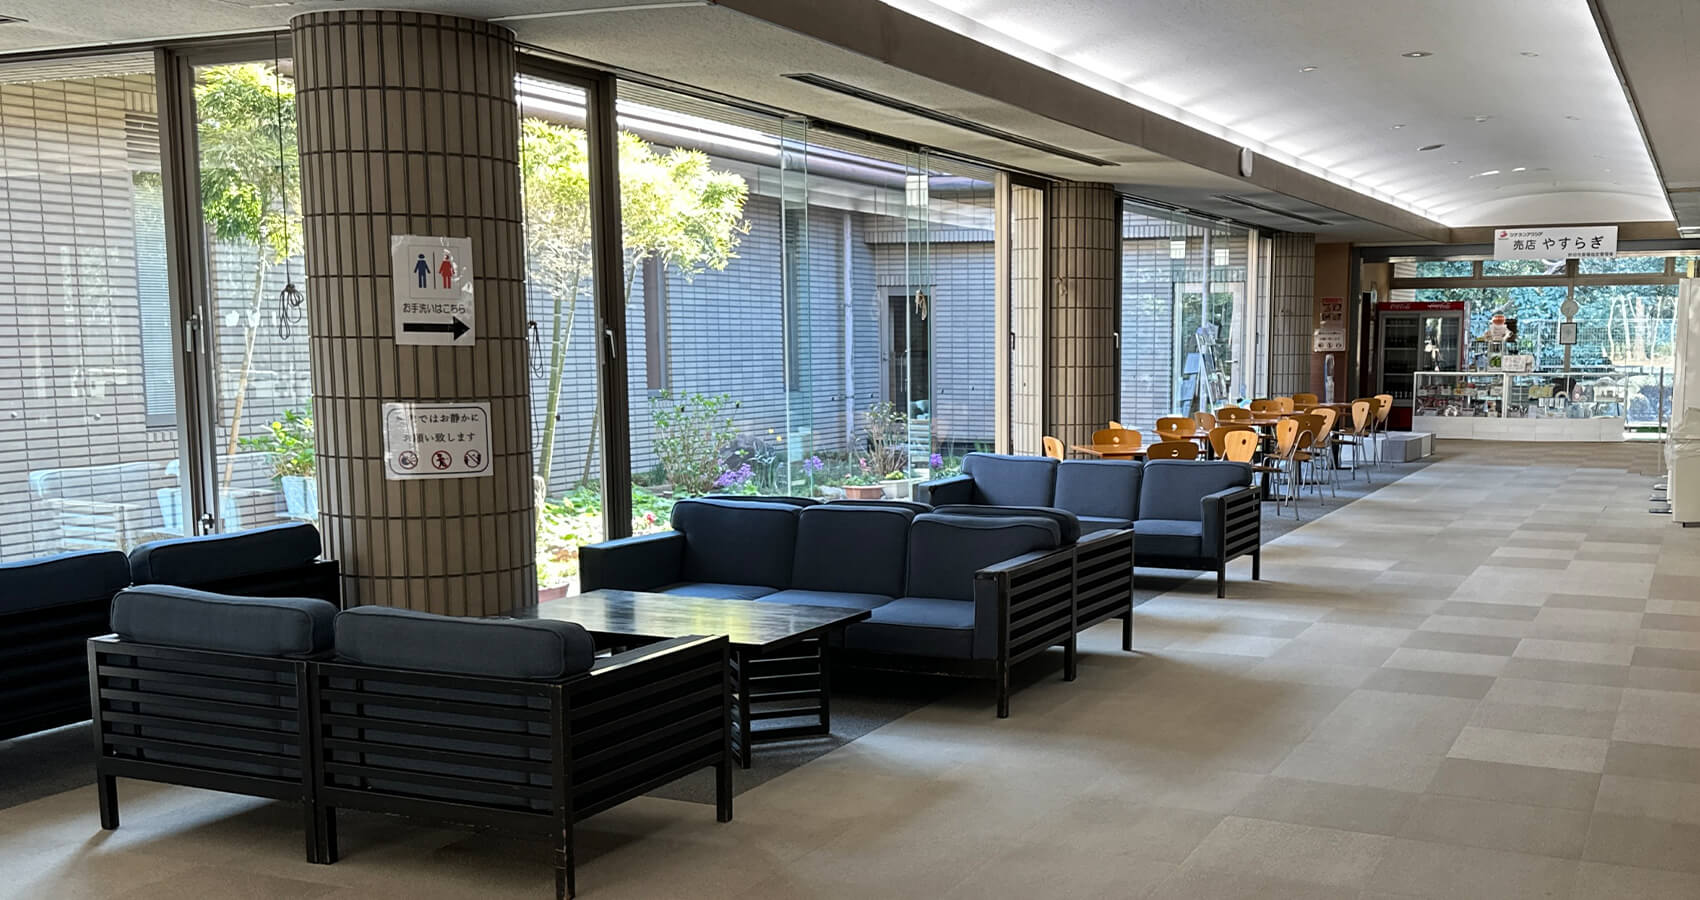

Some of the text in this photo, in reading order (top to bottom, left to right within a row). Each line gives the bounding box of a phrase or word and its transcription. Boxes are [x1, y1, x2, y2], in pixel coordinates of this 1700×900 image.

[1513, 235, 1604, 251] 売店 やすらぎ
[402, 302, 466, 314] お手洗いはこちら
[396, 413, 480, 424] ではお静かに
